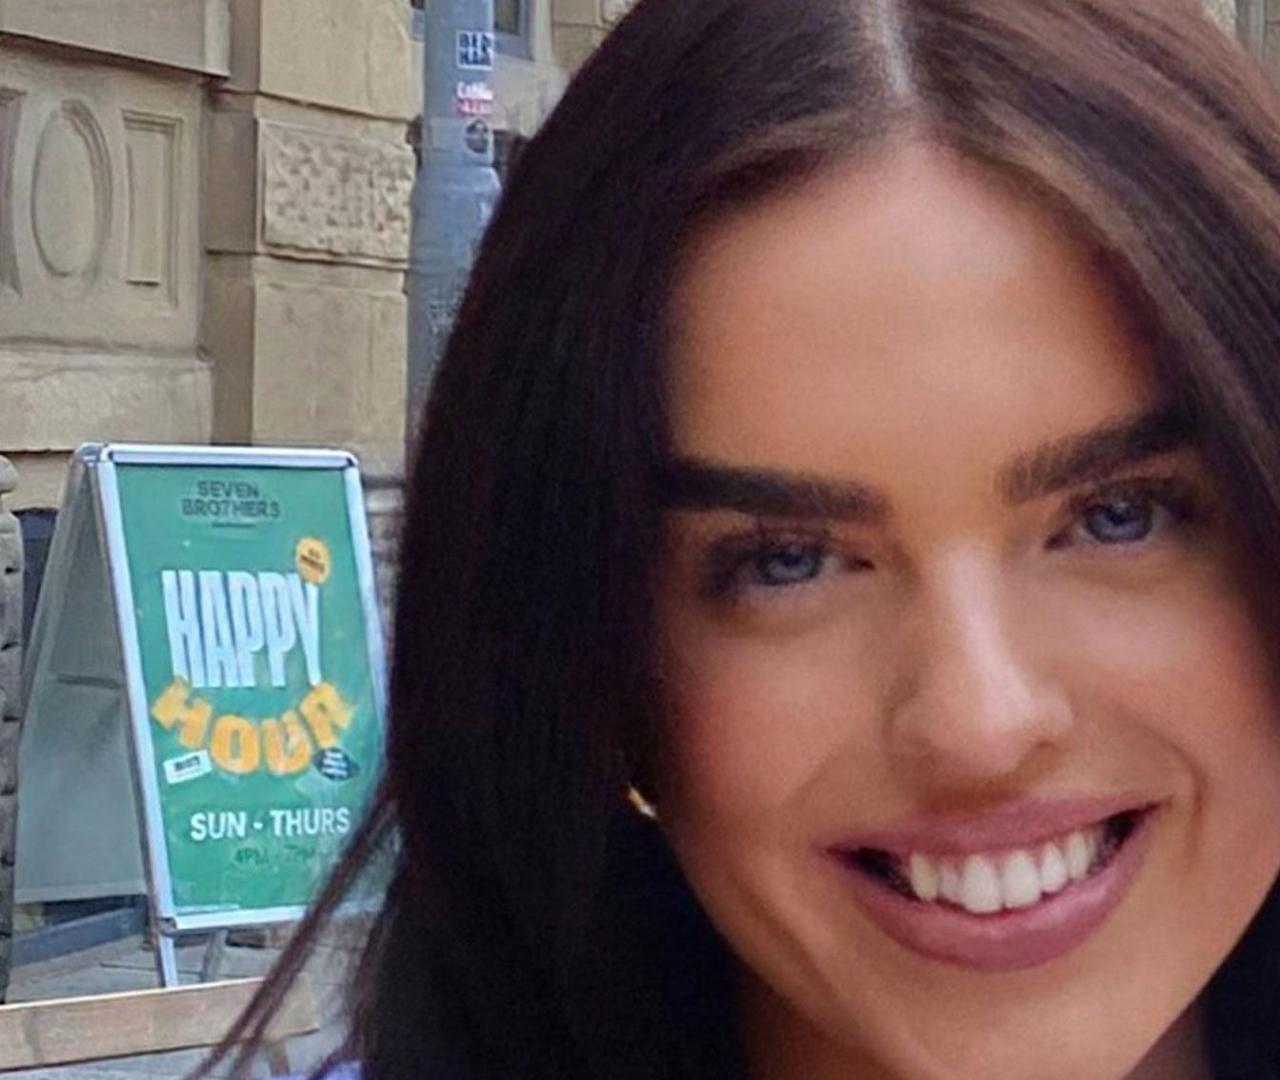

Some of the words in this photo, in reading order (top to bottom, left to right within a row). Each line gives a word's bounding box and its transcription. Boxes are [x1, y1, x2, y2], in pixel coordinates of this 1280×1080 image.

[197, 480, 260, 498] SEVEN
[181, 498, 282, 519] BROTHERS
[162, 570, 322, 688] HAPPY
[152, 680, 358, 776] HOUR
[190, 811, 247, 842] SUN
[269, 806, 351, 837] THURS
